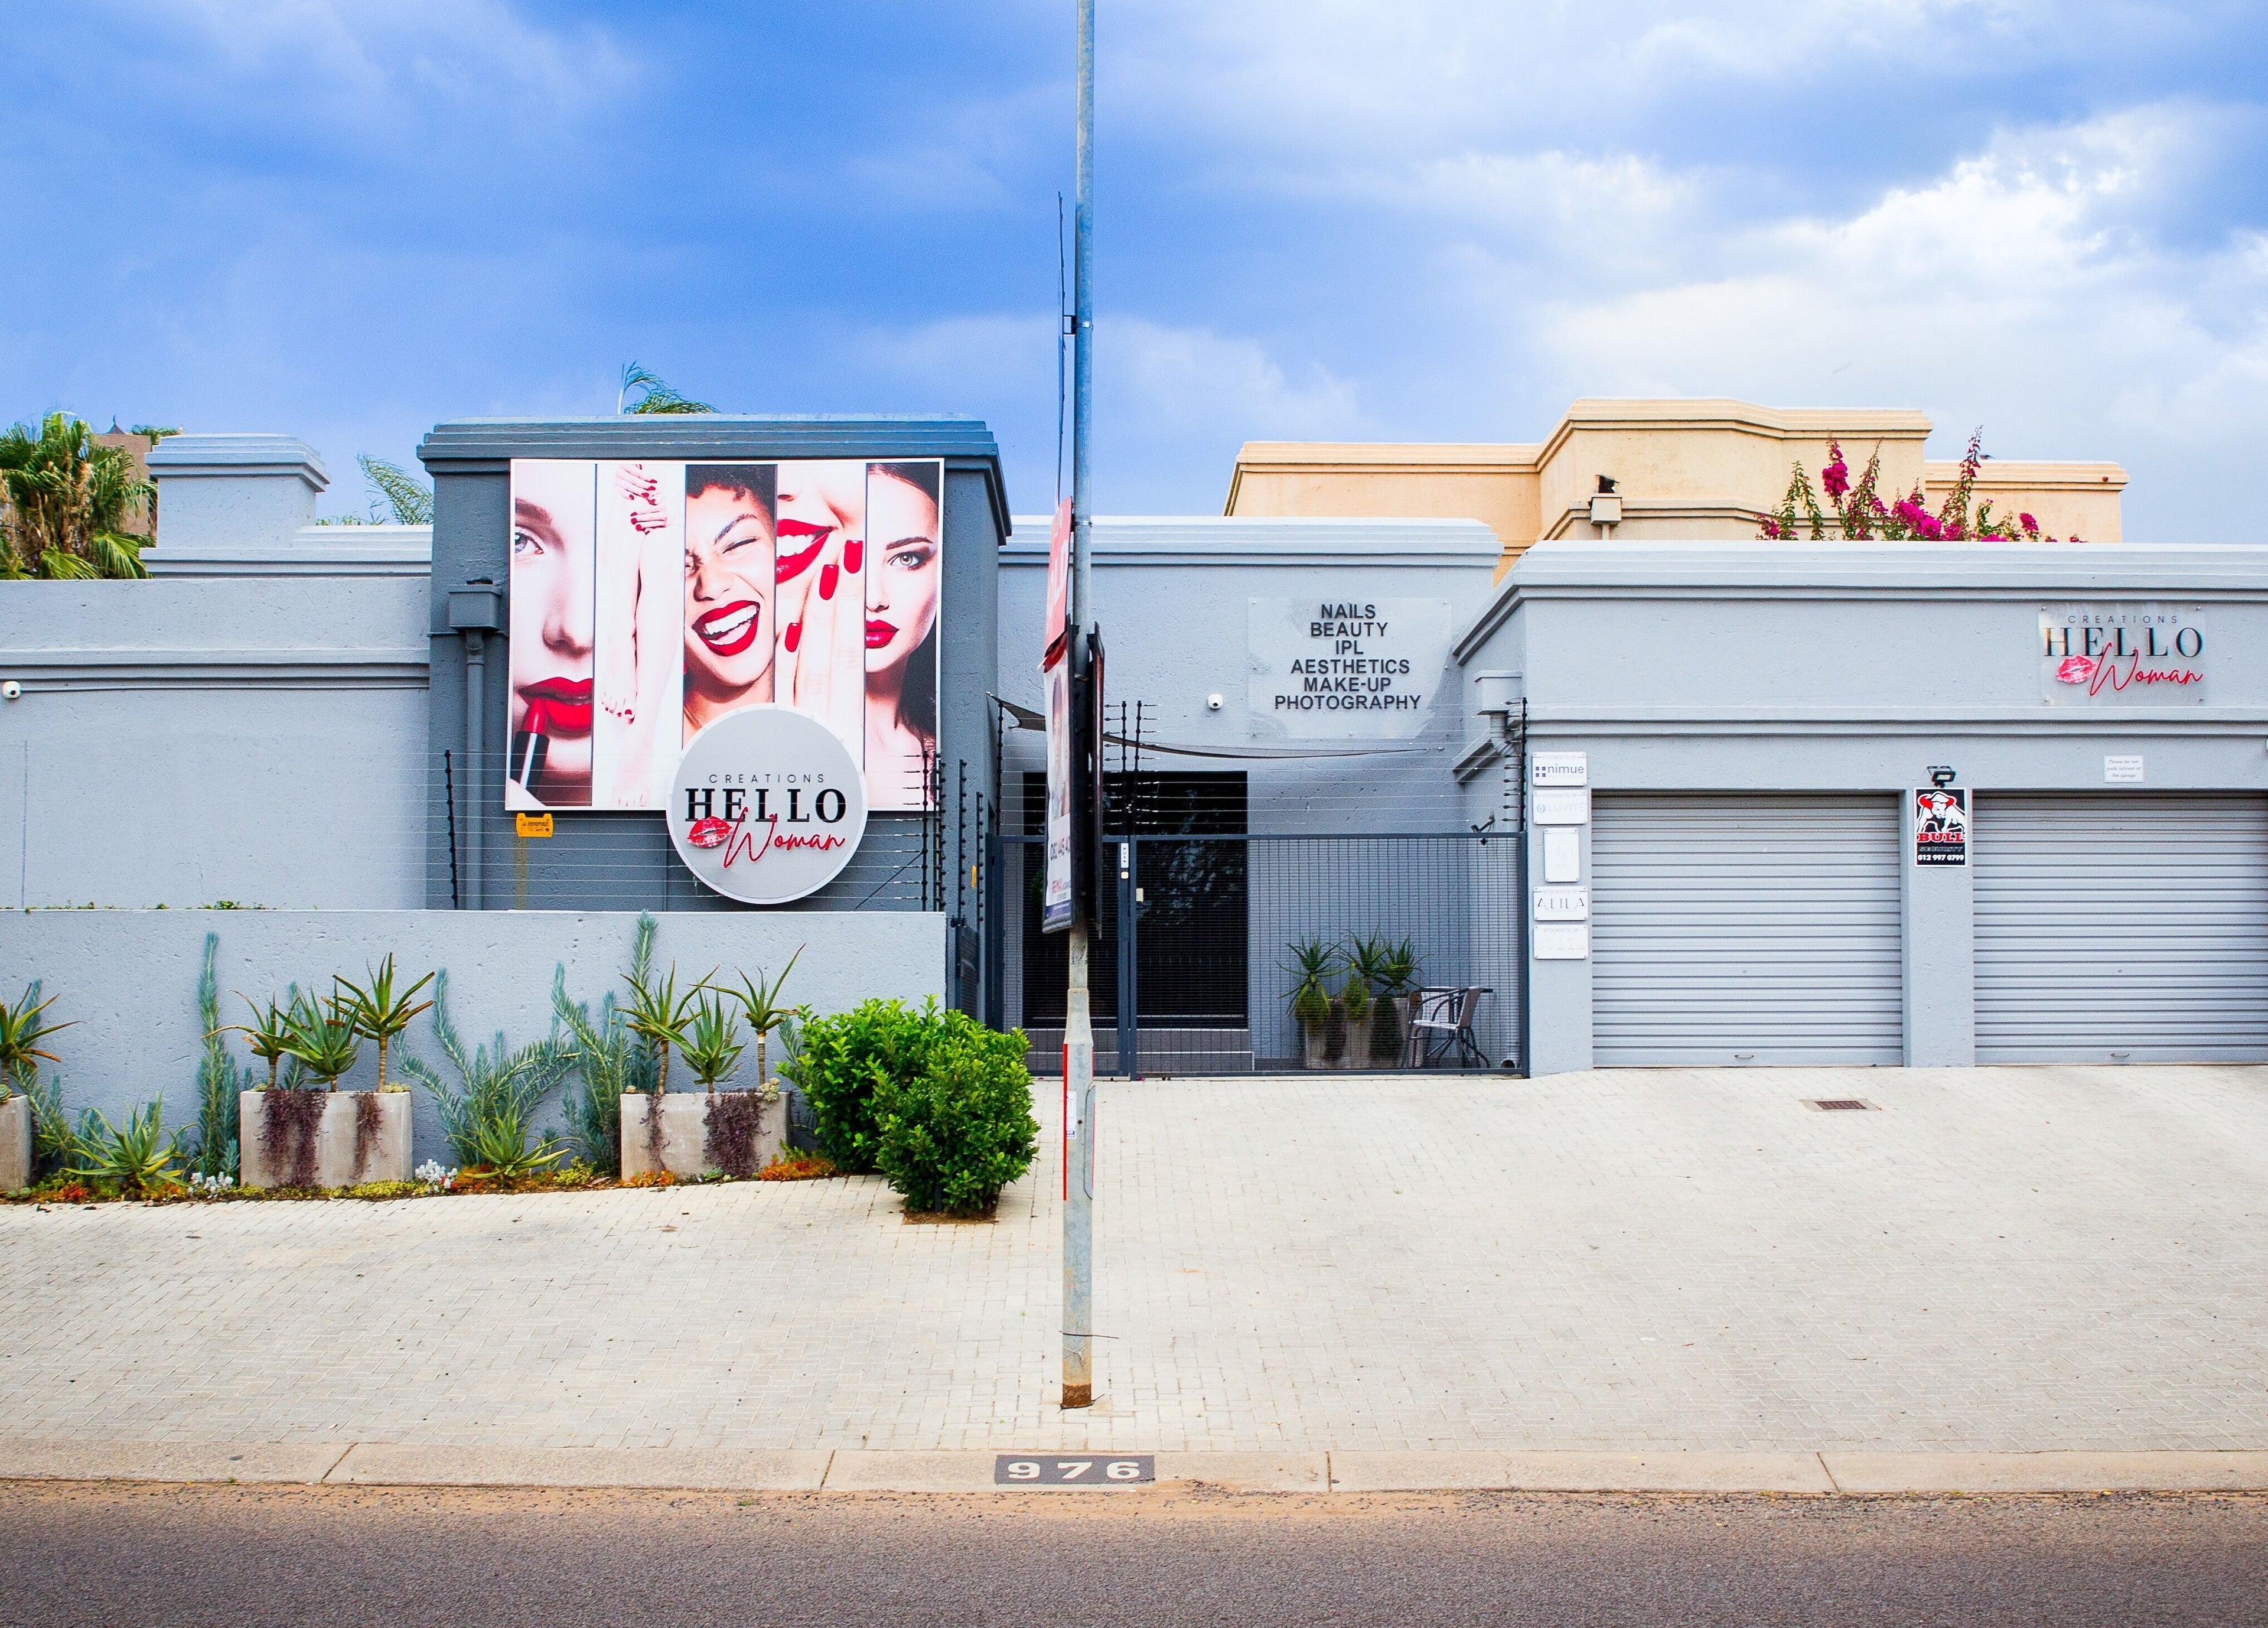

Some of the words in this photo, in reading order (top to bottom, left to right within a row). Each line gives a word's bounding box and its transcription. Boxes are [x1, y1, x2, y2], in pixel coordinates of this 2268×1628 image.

[1321, 604, 1376, 619] NAILS
[2067, 615, 2179, 624] CREATIONS
[1310, 622, 1389, 637] BEAUTY
[1335, 640, 1364, 655] IPL
[2043, 627, 2204, 658] HELLO
[1290, 659, 1410, 674] AESTHETICS
[2089, 642, 2204, 696] Woman
[1303, 677, 1392, 692] MAKE-UP
[1275, 695, 1422, 710] PHOTOGRAPHY
[1547, 764, 1584, 773] nimue
[709, 774, 825, 783] CREATIONS
[685, 788, 847, 823] HELLO
[723, 806, 846, 869] Woman
[1917, 832, 1964, 842] BULL
[1007, 1461, 1140, 1480] 976
